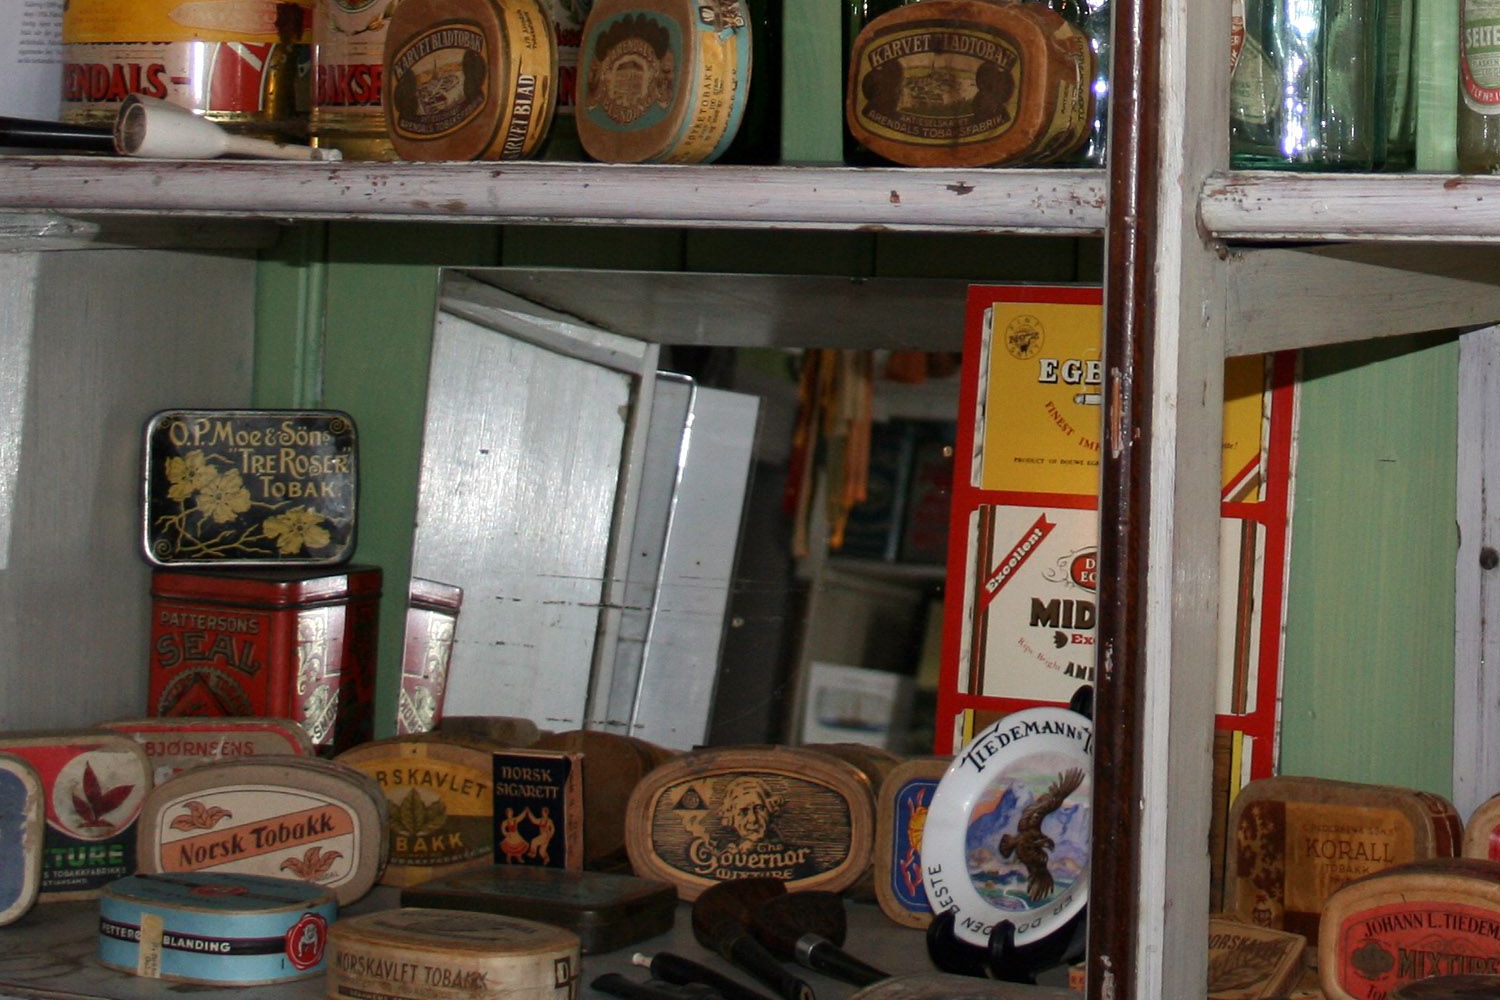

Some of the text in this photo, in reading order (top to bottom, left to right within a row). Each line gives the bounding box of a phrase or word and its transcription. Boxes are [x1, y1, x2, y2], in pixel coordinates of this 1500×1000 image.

[871, 36, 932, 66] KARVET
[514, 74, 537, 117] BLAD
[921, 115, 1005, 138] TOBASFABRIK
[1044, 400, 1075, 438] FINEST
[1013, 456, 1045, 465] PRODUCT
[985, 528, 1043, 593] Excellent
[156, 632, 260, 678] SEAL
[145, 740, 255, 757] BJØRNSENS
[501, 765, 553, 783] NORSK
[496, 783, 560, 800] SIGARETT
[179, 812, 336, 867] Norsk Tobakk
[1305, 837, 1396, 865] KORALL
[690, 836, 813, 875] Governor
[1363, 911, 1425, 938] JOHANN
[1426, 911, 1441, 930] L.
[162, 934, 232, 953] BLANDING
[335, 951, 419, 987] NORSKAVLET
[1397, 946, 1500, 979] MIXTURE
